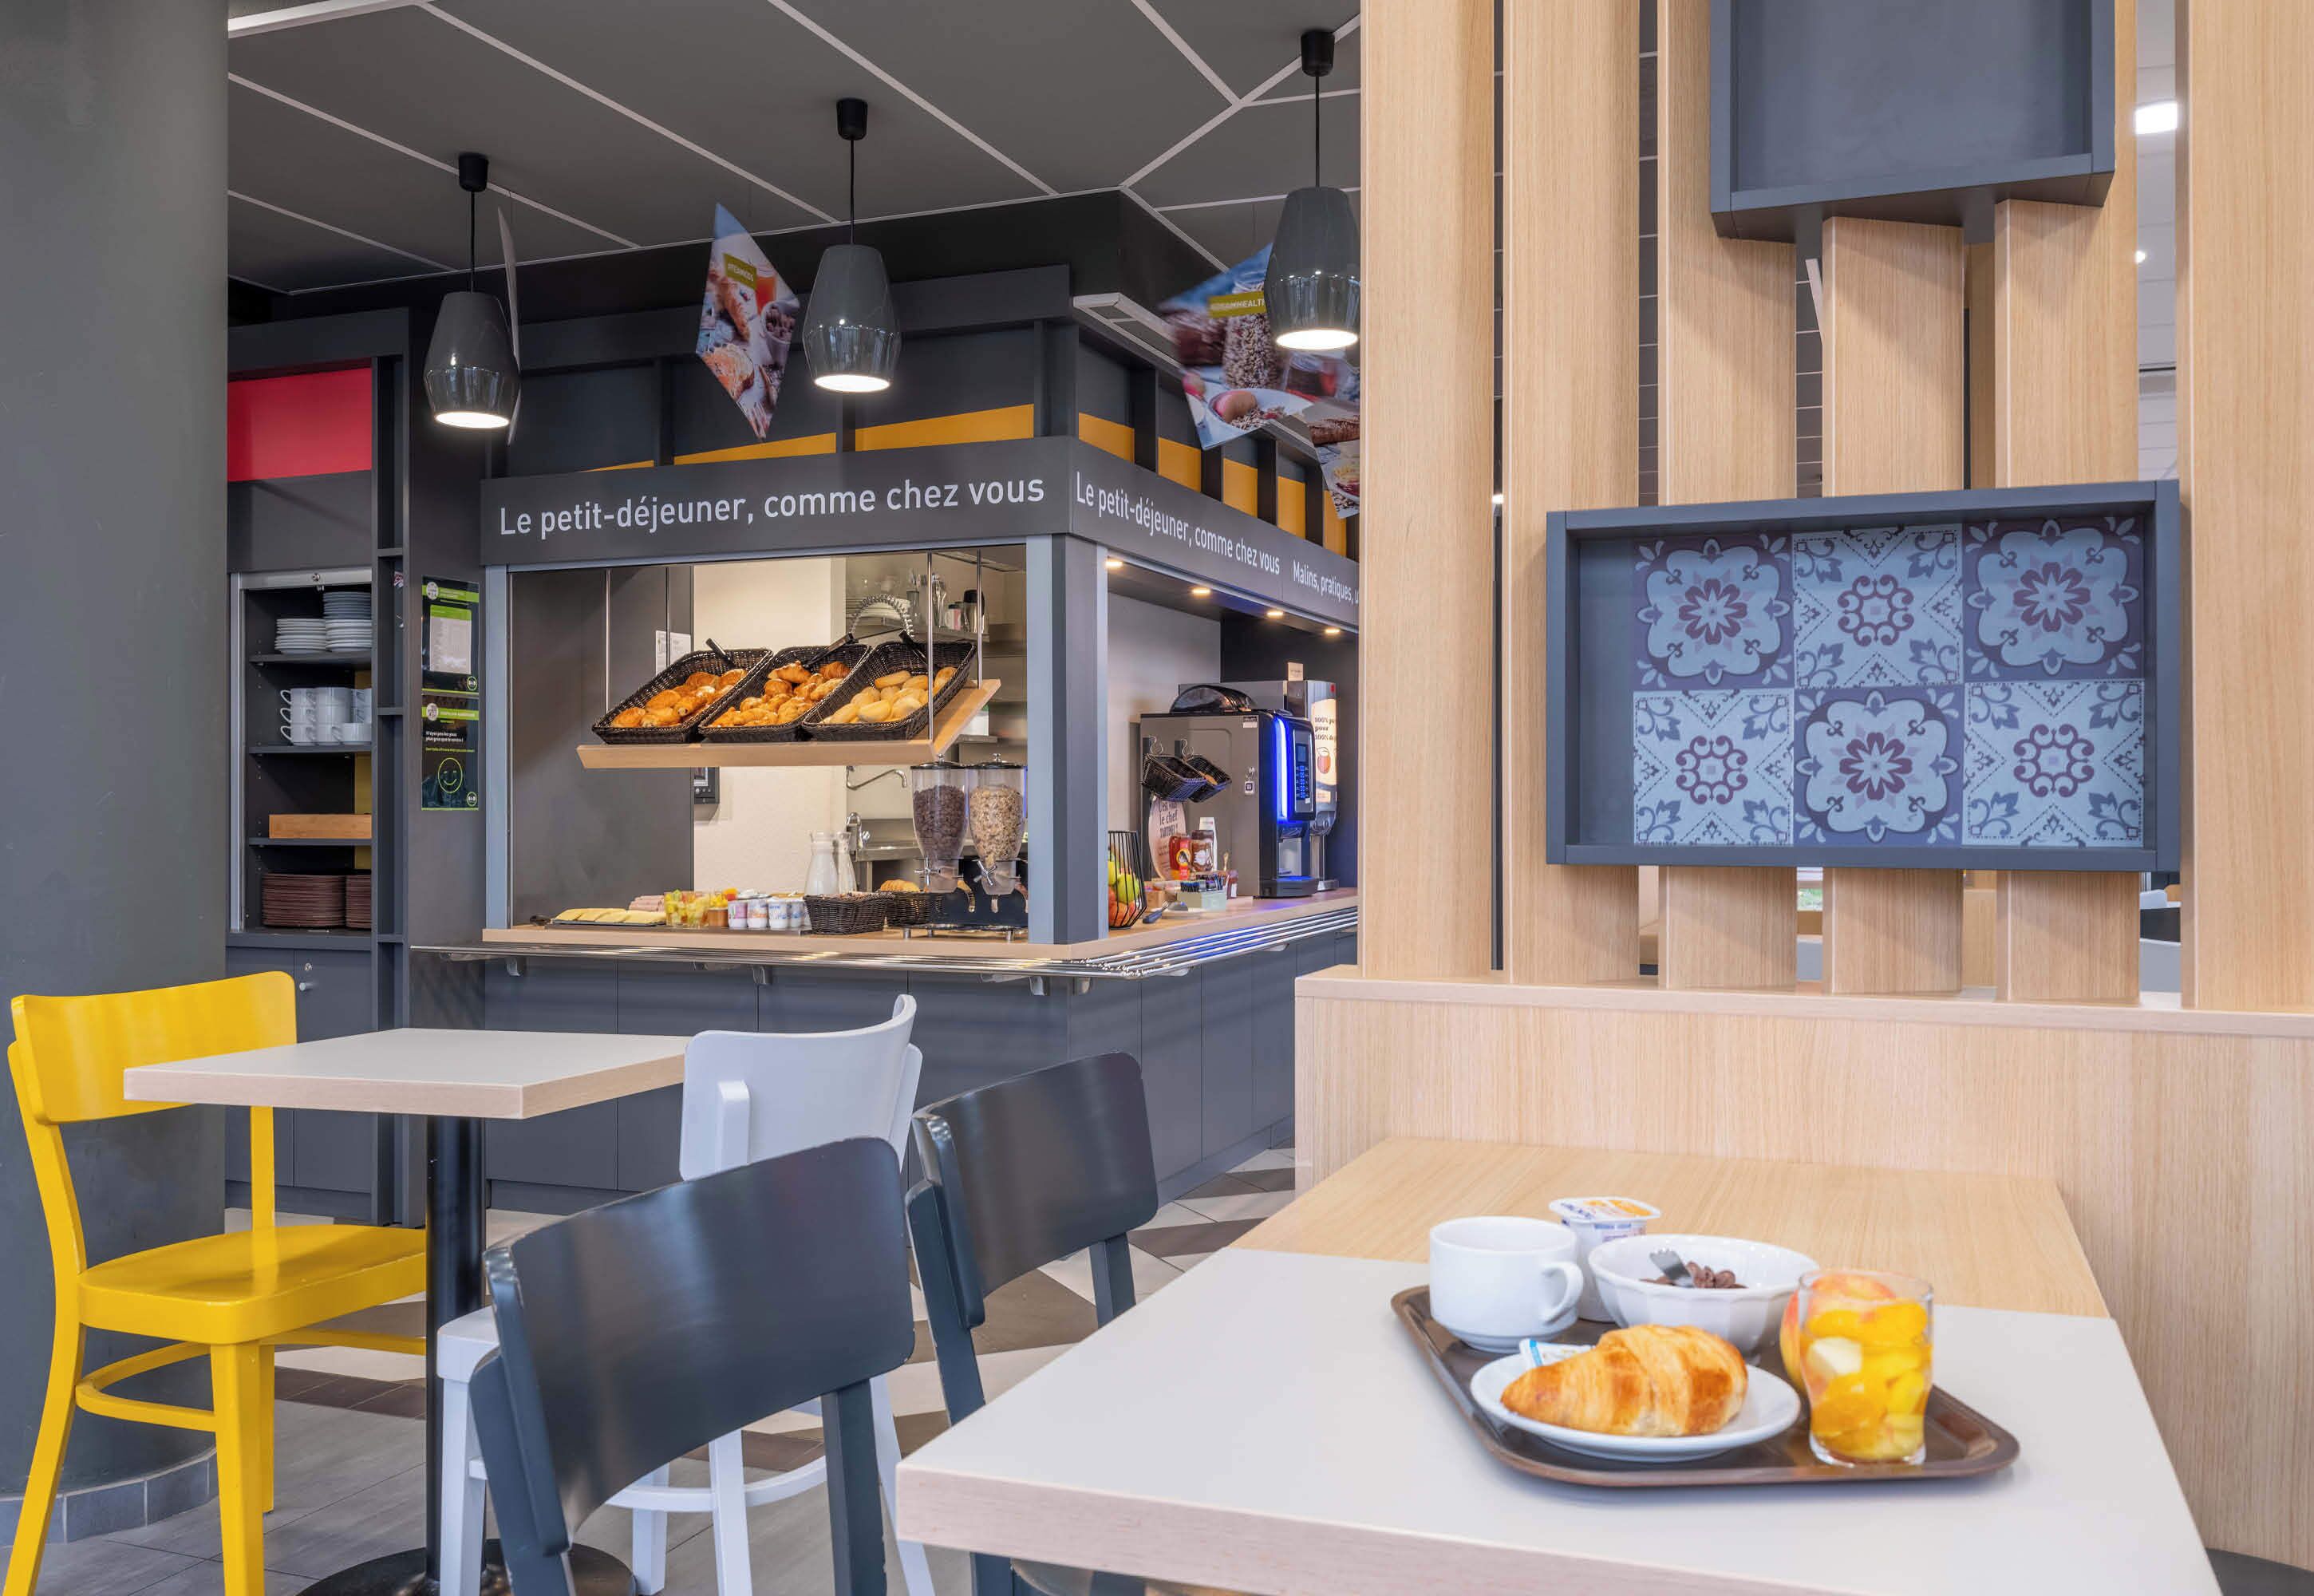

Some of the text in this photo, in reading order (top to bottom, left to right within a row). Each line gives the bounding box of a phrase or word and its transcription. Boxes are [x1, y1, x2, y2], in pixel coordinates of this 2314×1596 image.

[500, 478, 1044, 540] Le petit-déjeuner, comme chez vous
[1076, 471, 1280, 575] Le petit-déjeuner, comme chez vous
[1293, 559, 1319, 593] Malins,
[1321, 575, 1353, 605] pratiques,
